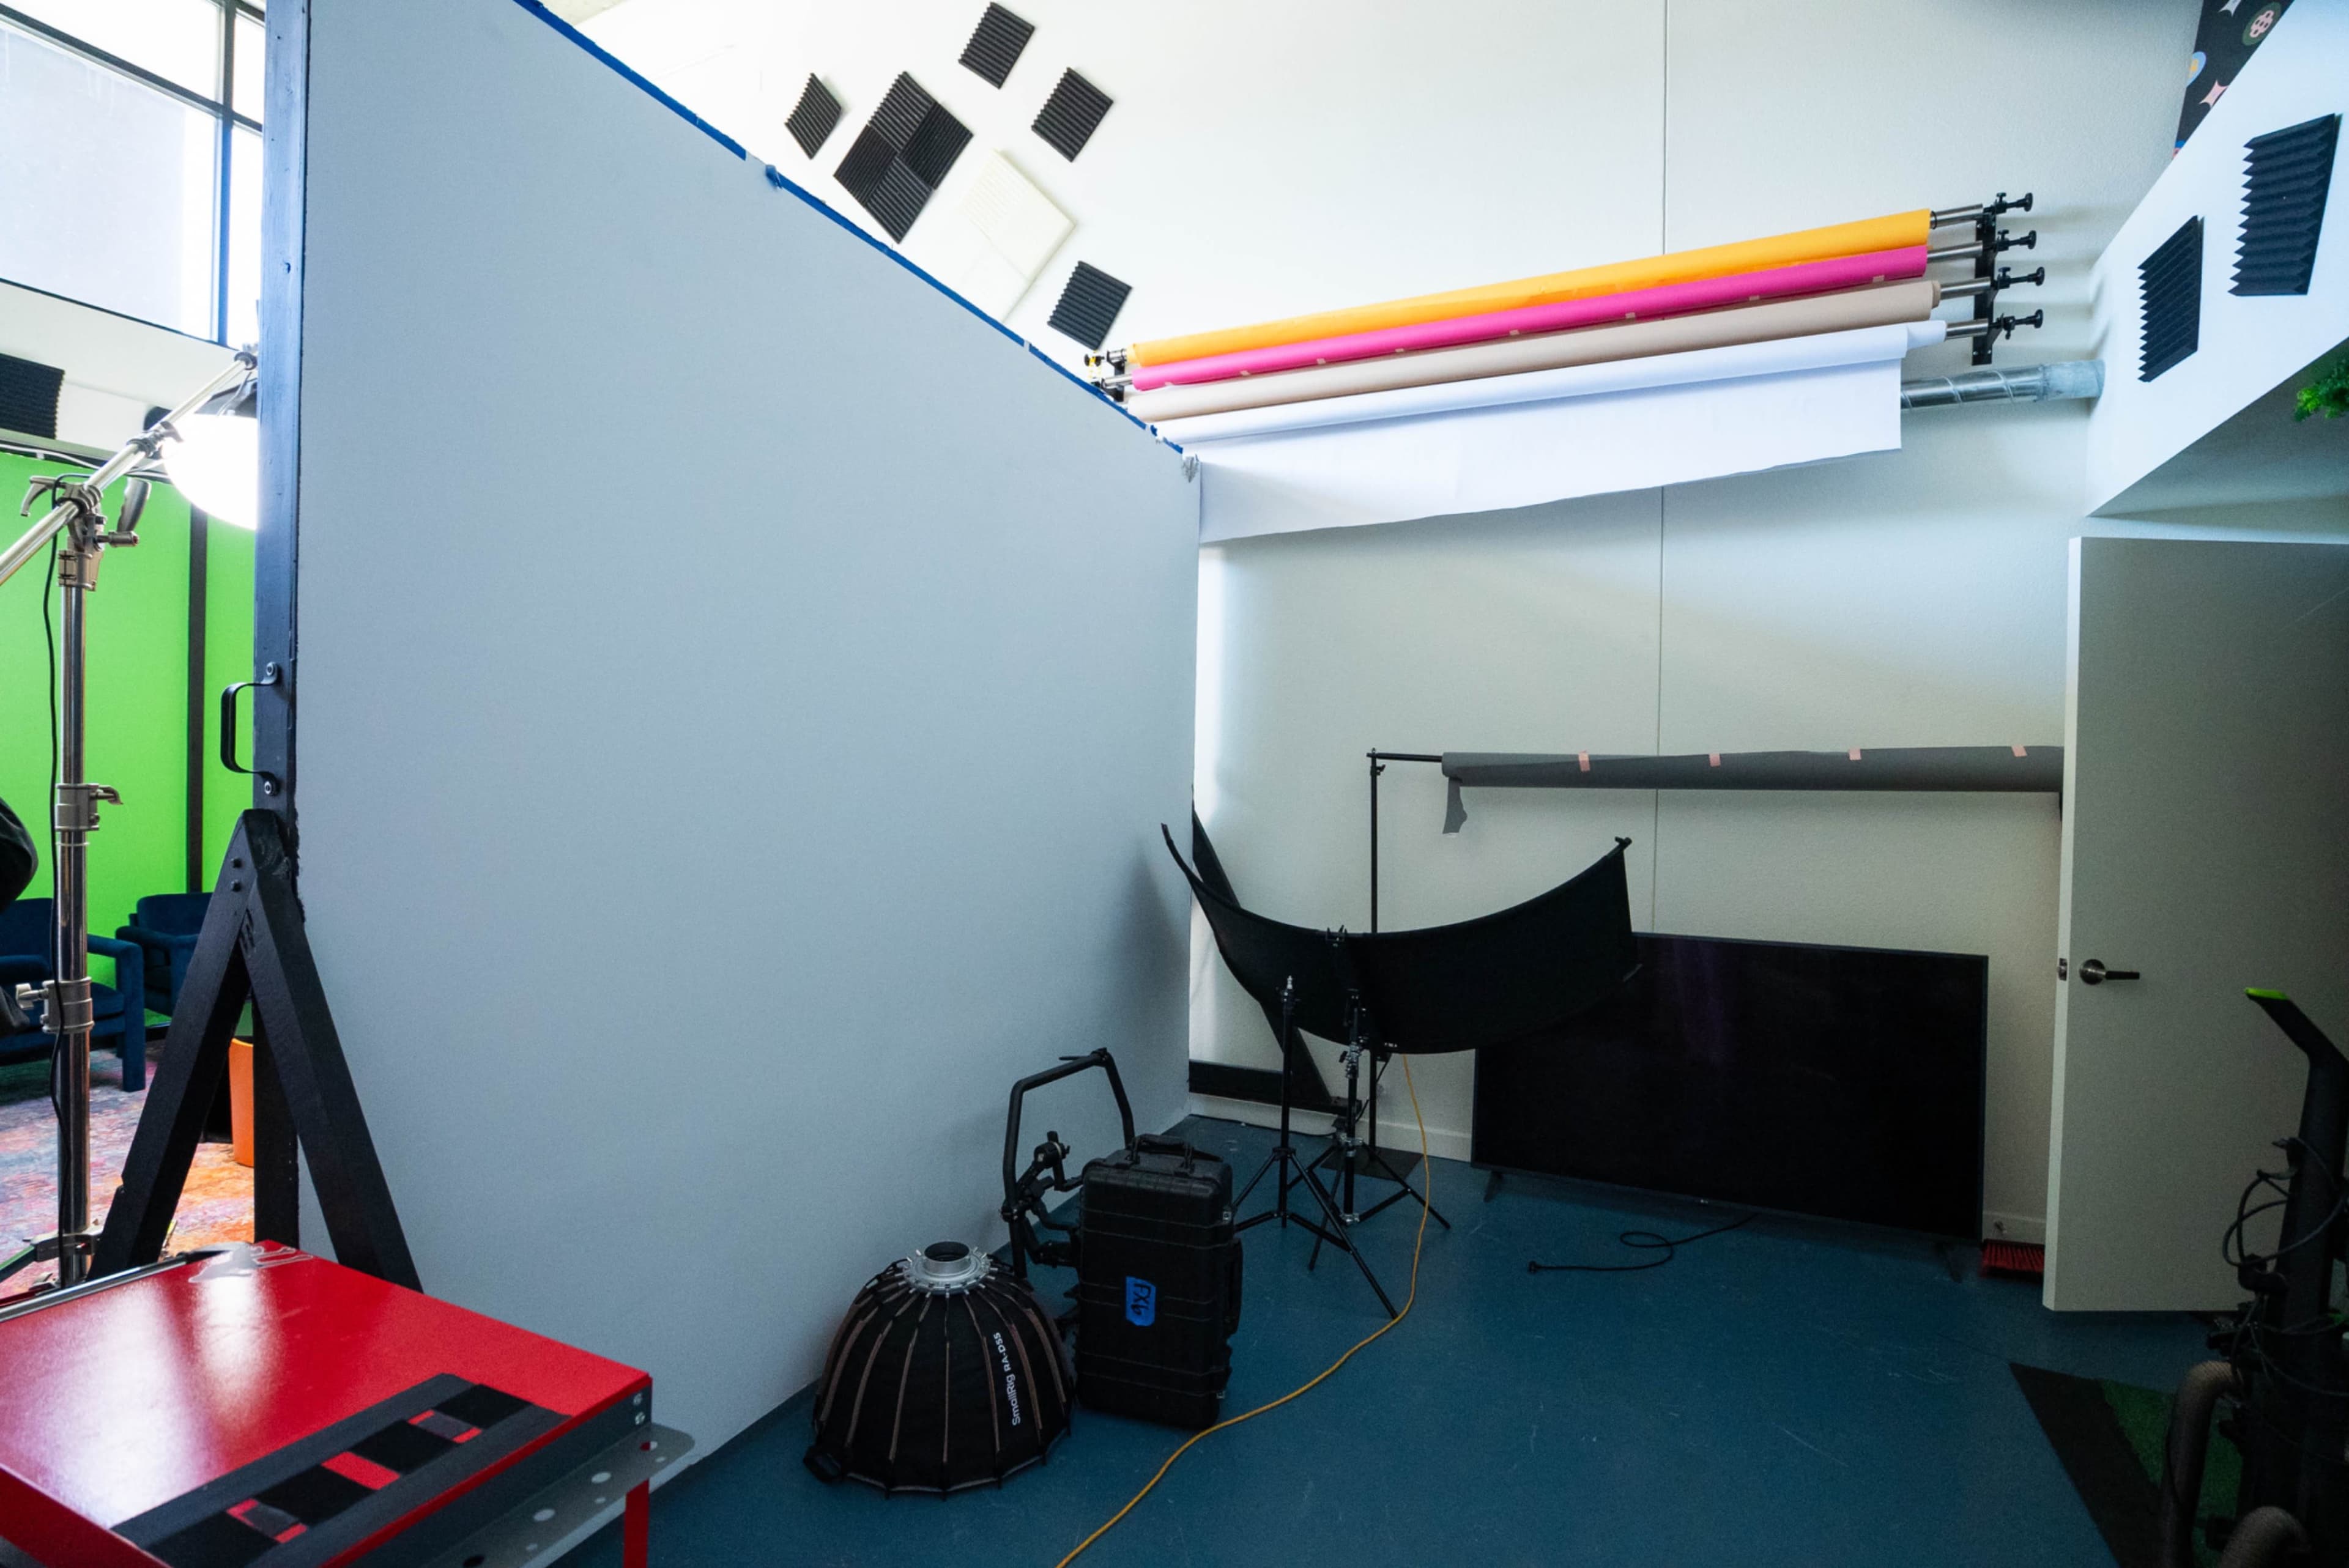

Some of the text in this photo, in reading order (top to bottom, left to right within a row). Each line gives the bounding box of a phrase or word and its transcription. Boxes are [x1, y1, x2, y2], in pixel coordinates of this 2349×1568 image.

[1130, 1284, 1151, 1316] FX6
[993, 1332, 1021, 1426] SmallRig RA-D55
